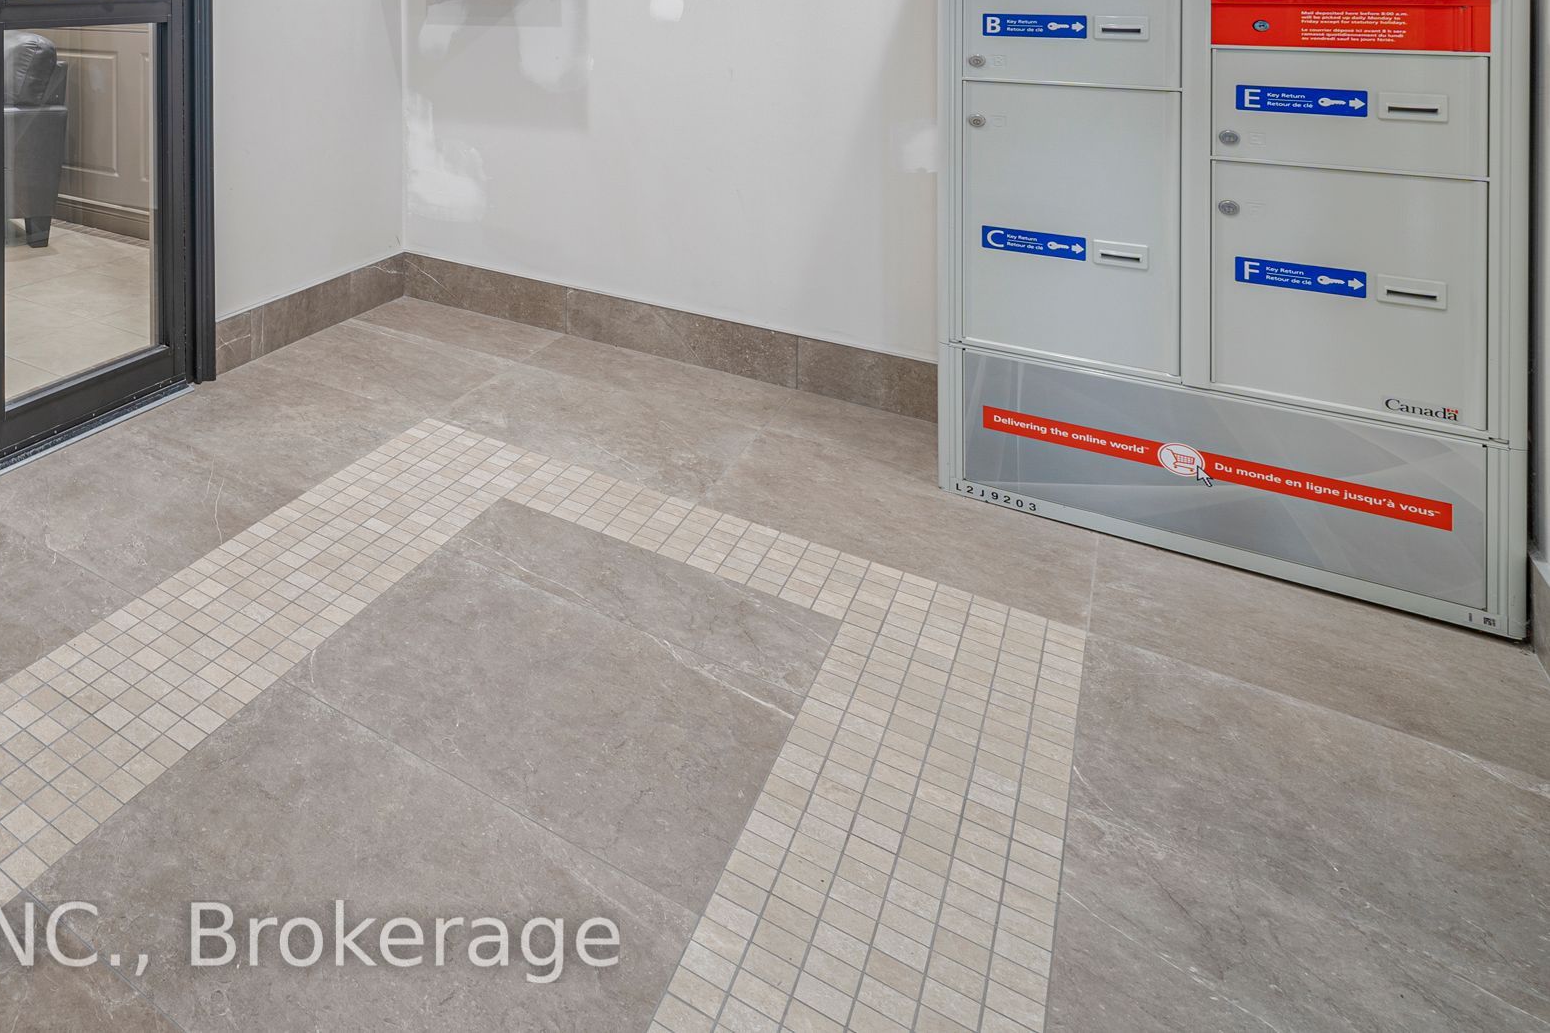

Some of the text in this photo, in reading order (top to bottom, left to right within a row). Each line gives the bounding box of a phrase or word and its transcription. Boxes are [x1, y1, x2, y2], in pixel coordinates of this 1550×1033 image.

[986, 17, 1001, 33] B
[1244, 89, 1261, 108] E
[987, 230, 1004, 248] C
[1244, 261, 1260, 280] F
[1385, 398, 1459, 421] Canada
[993, 415, 1048, 434] Delivering
[1050, 427, 1069, 438] the
[1071, 432, 1107, 446] online
[1214, 462, 1233, 473] Du
[1236, 468, 1282, 483] monde
[1285, 478, 1301, 488] en
[1306, 481, 1340, 497] ligne
